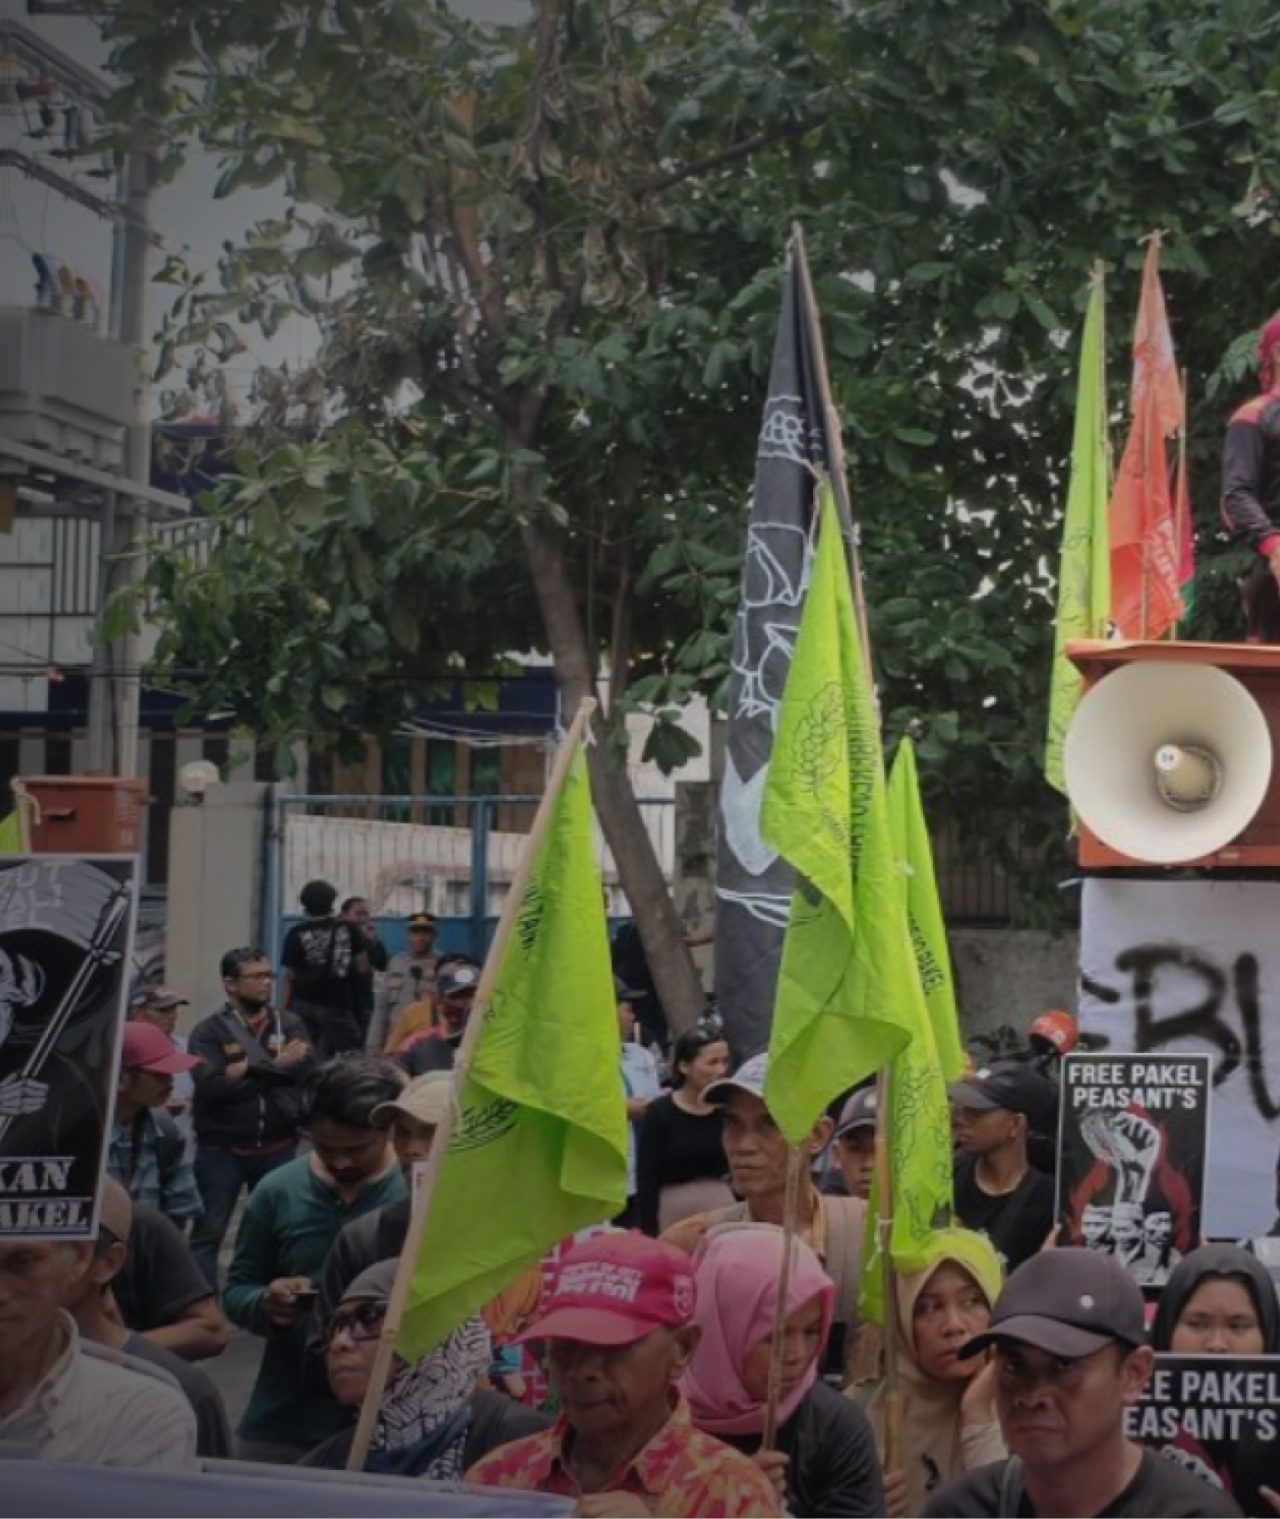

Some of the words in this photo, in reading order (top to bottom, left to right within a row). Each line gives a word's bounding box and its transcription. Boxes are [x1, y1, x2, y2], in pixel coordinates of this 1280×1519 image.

[1068, 1062, 1125, 1085] FREE
[1131, 1063, 1204, 1087] PAKEL
[1072, 1087, 1197, 1110] PEASANT'S
[1121, 1405, 1278, 1441] EASANT'S
